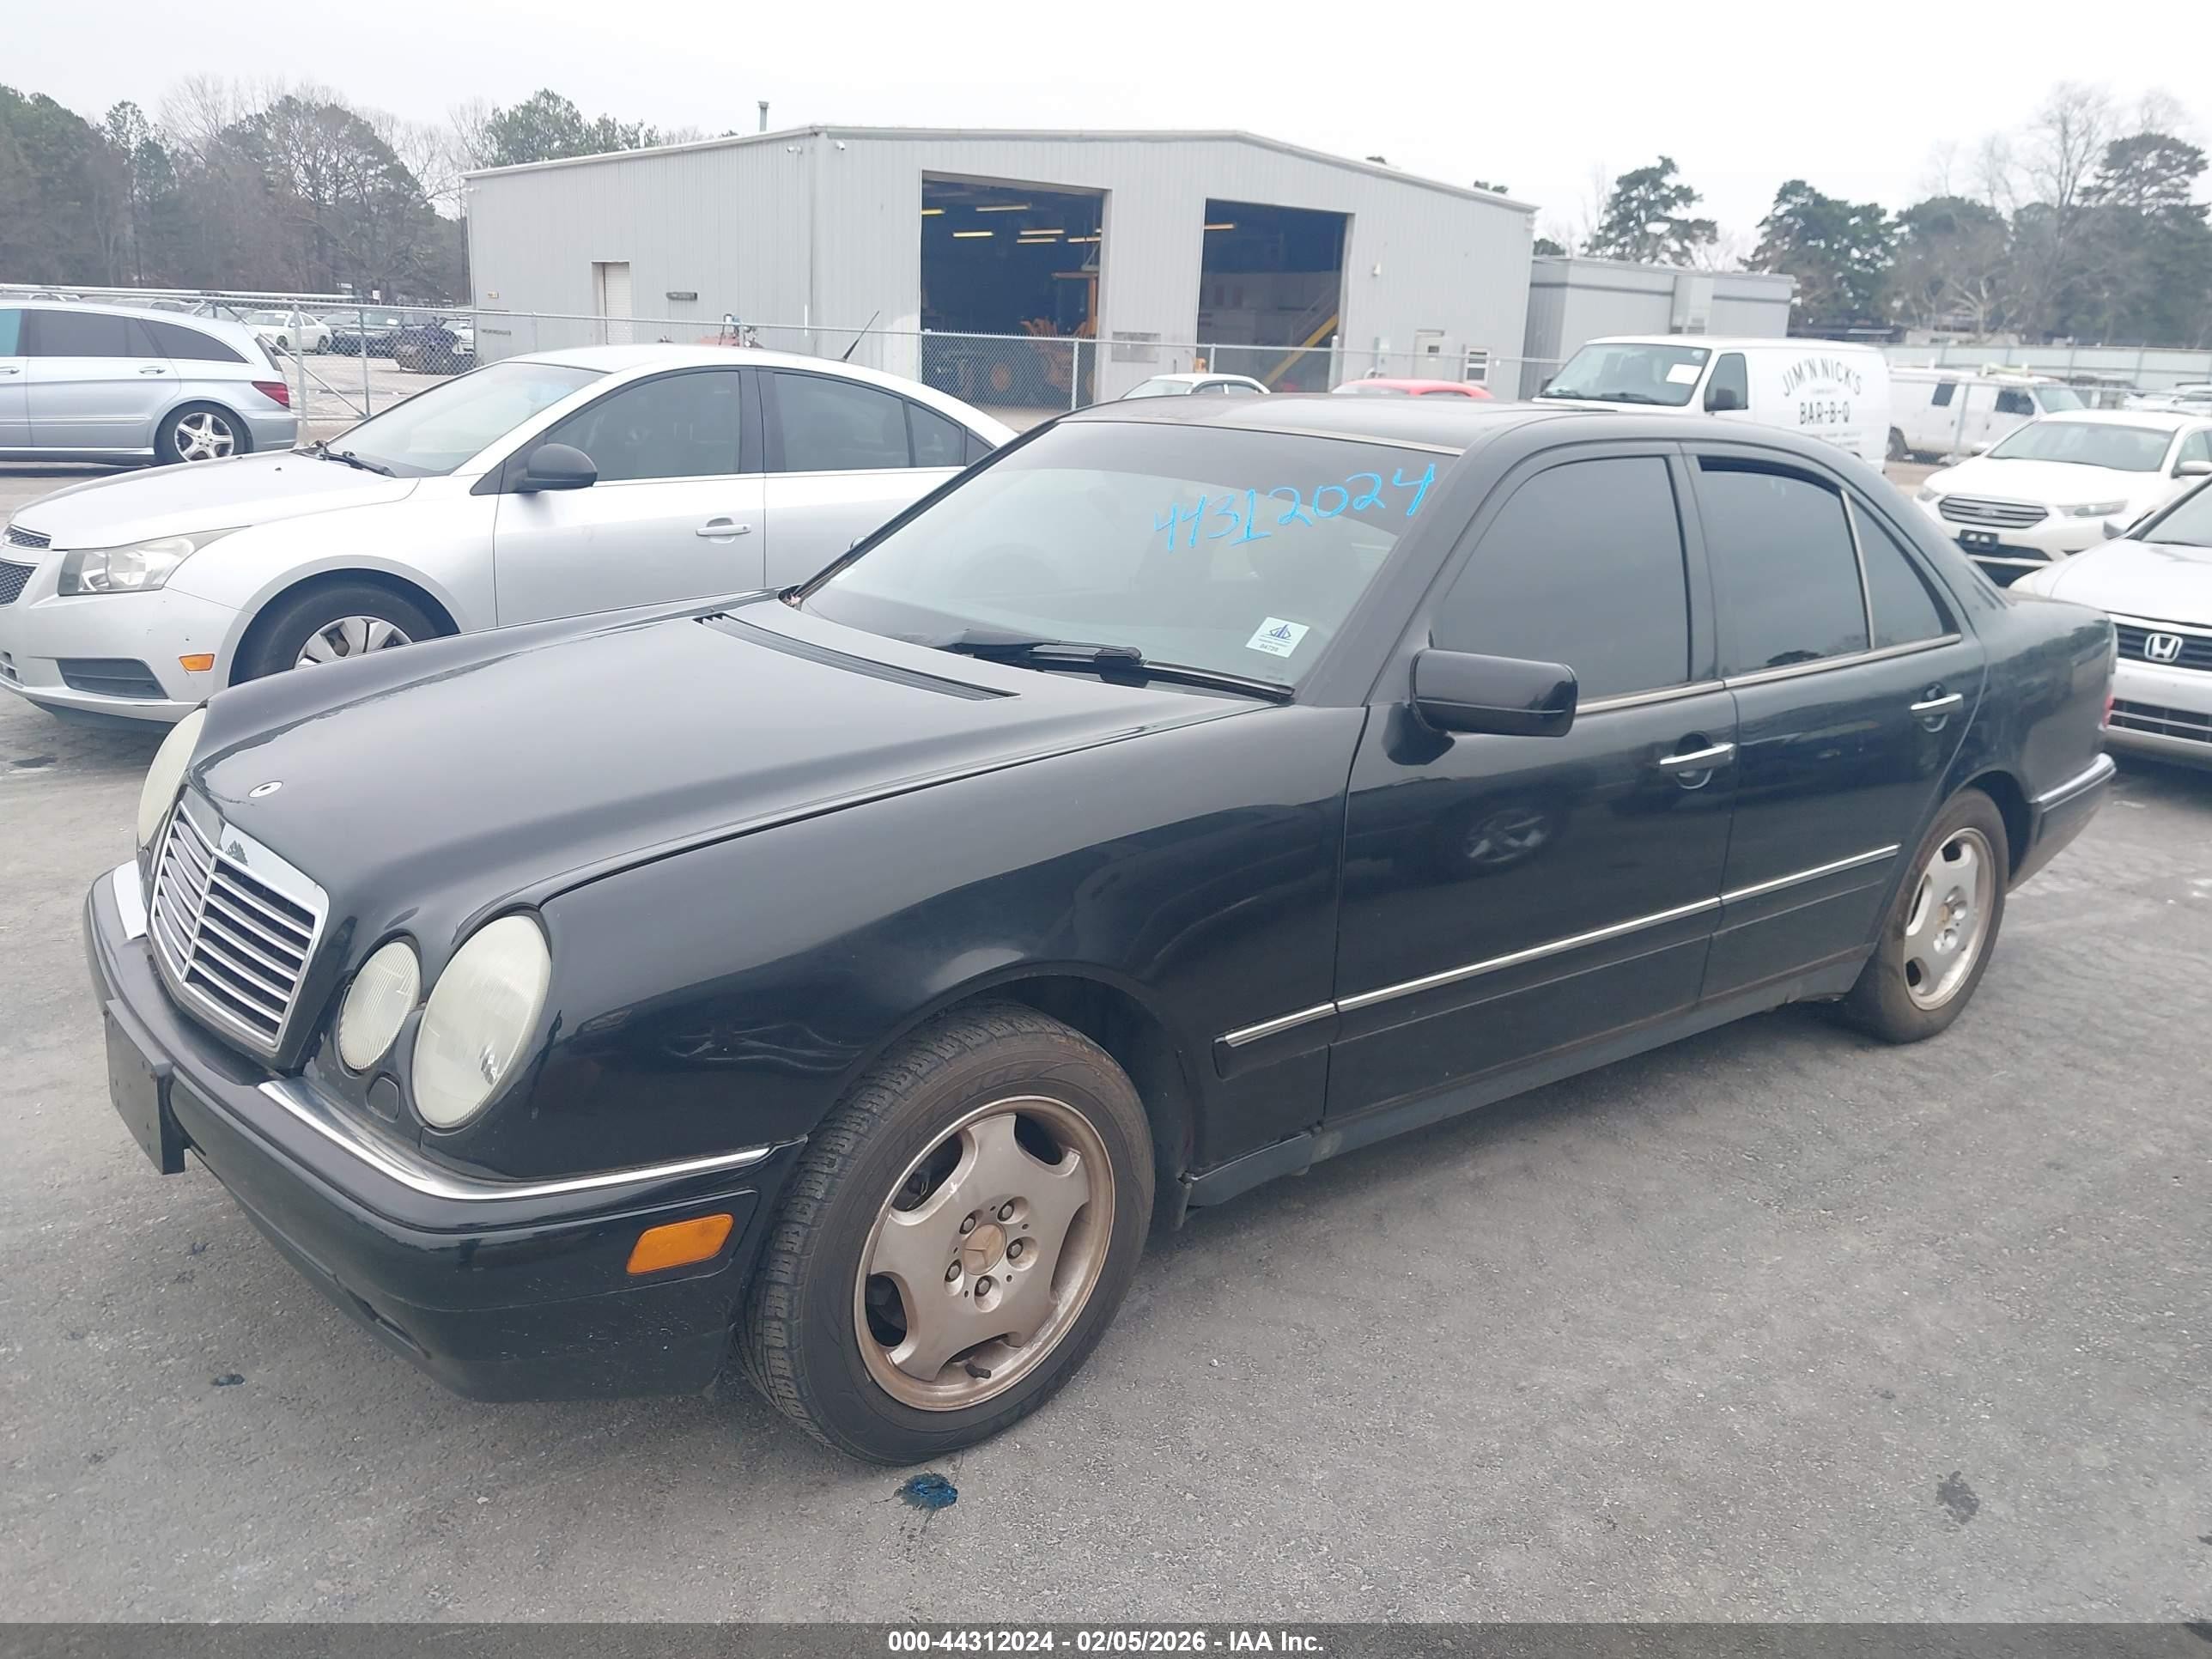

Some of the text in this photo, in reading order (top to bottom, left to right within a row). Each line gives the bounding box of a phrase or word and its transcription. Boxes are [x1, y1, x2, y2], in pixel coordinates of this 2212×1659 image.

[1820, 357, 1862, 396] NICK'S
[1800, 401, 1850, 424] BAR-B-Q
[1153, 463, 1436, 551] 44312024
